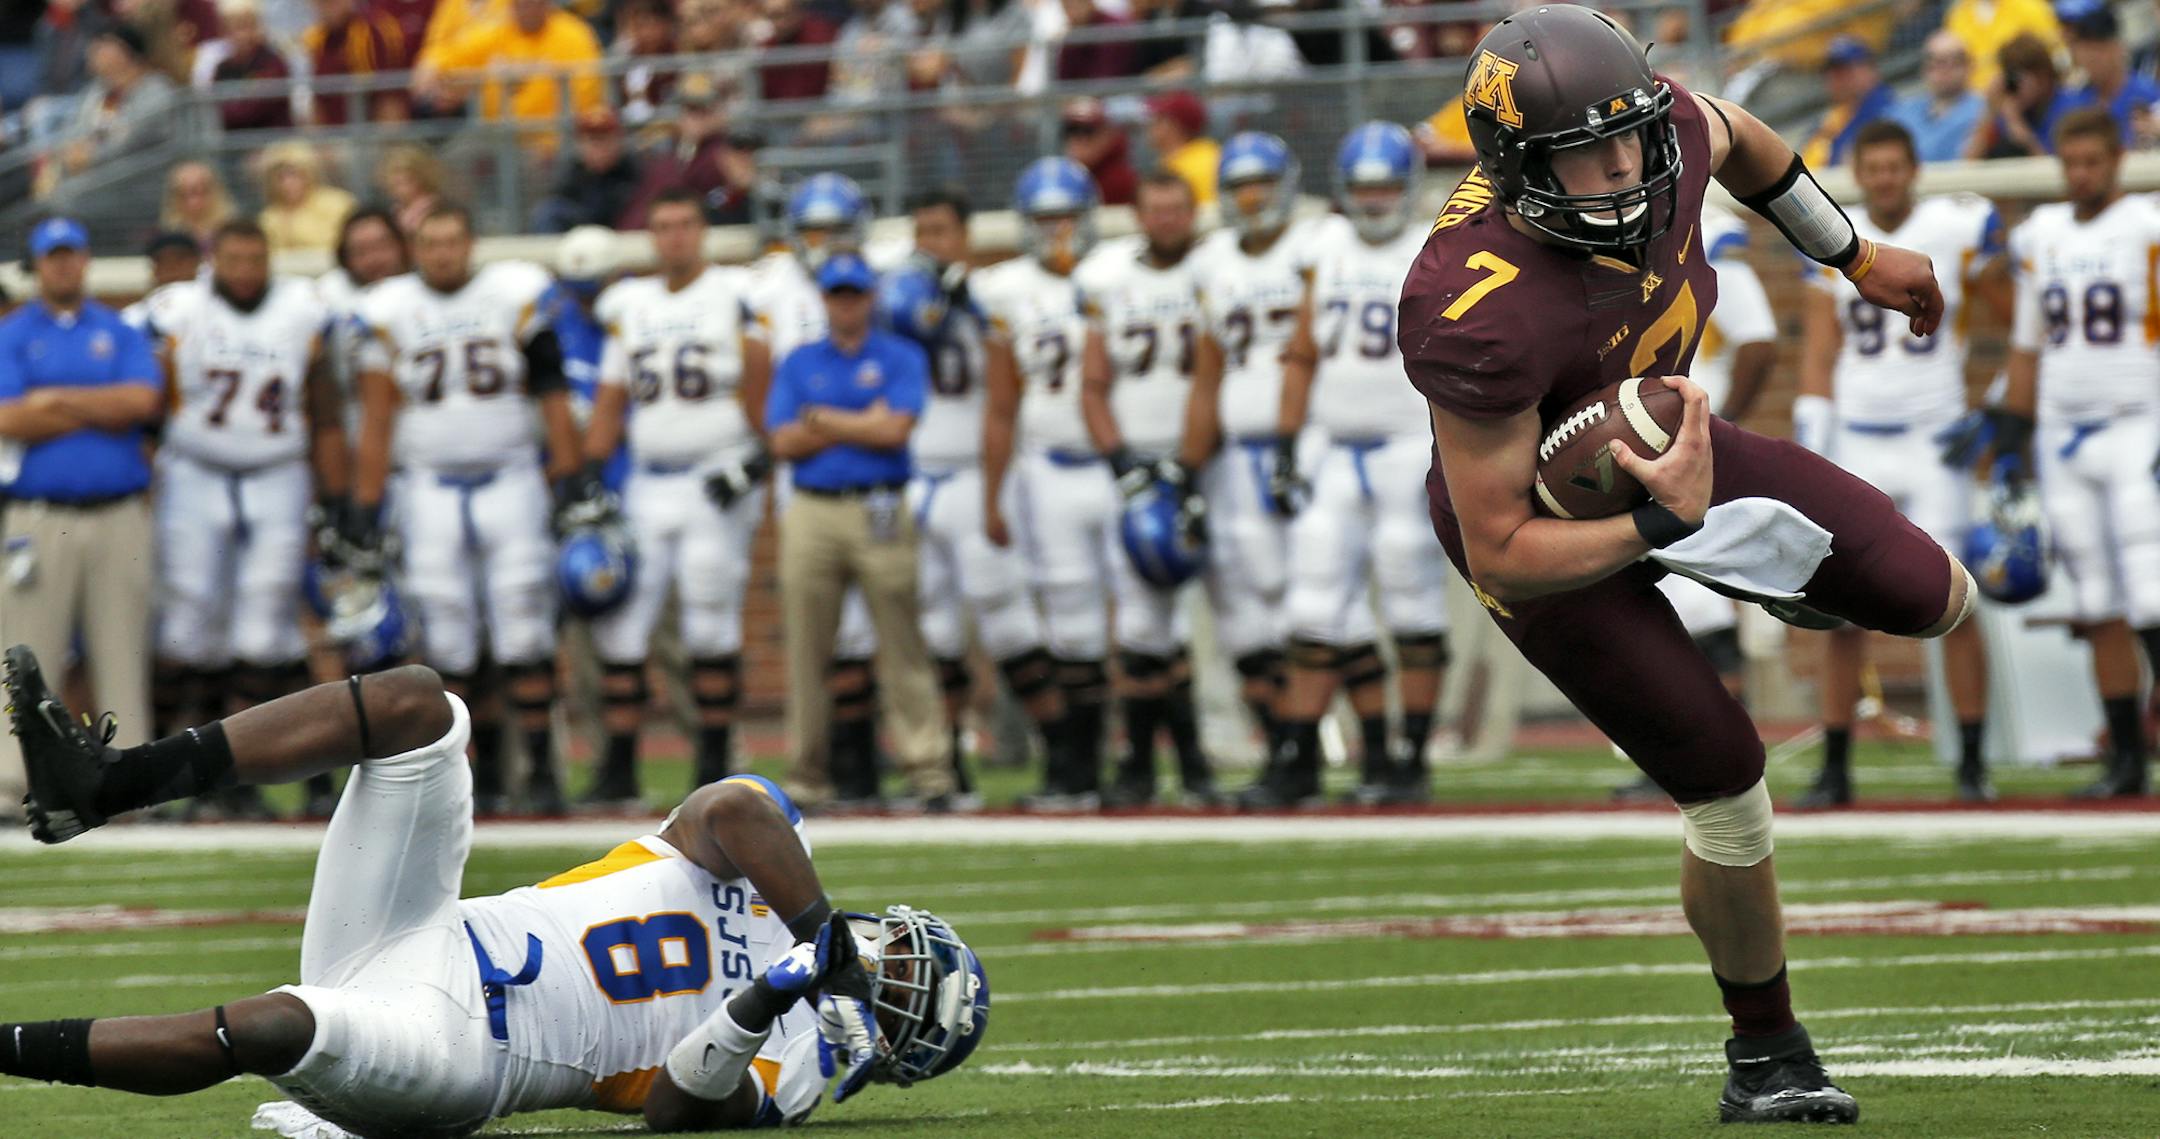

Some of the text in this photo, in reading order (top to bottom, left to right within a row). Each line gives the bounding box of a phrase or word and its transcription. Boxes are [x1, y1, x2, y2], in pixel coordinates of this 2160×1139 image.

[1464, 48, 1524, 129] M
[1609, 97, 1629, 115] M
[1440, 249, 1521, 322] 7
[1122, 322, 1197, 377] 71
[1322, 299, 1396, 361] 79
[1629, 278, 1698, 379] 7
[205, 367, 288, 436] 74
[413, 337, 507, 403] 75
[579, 910, 713, 1005] 8
[711, 882, 754, 1000] SJS
